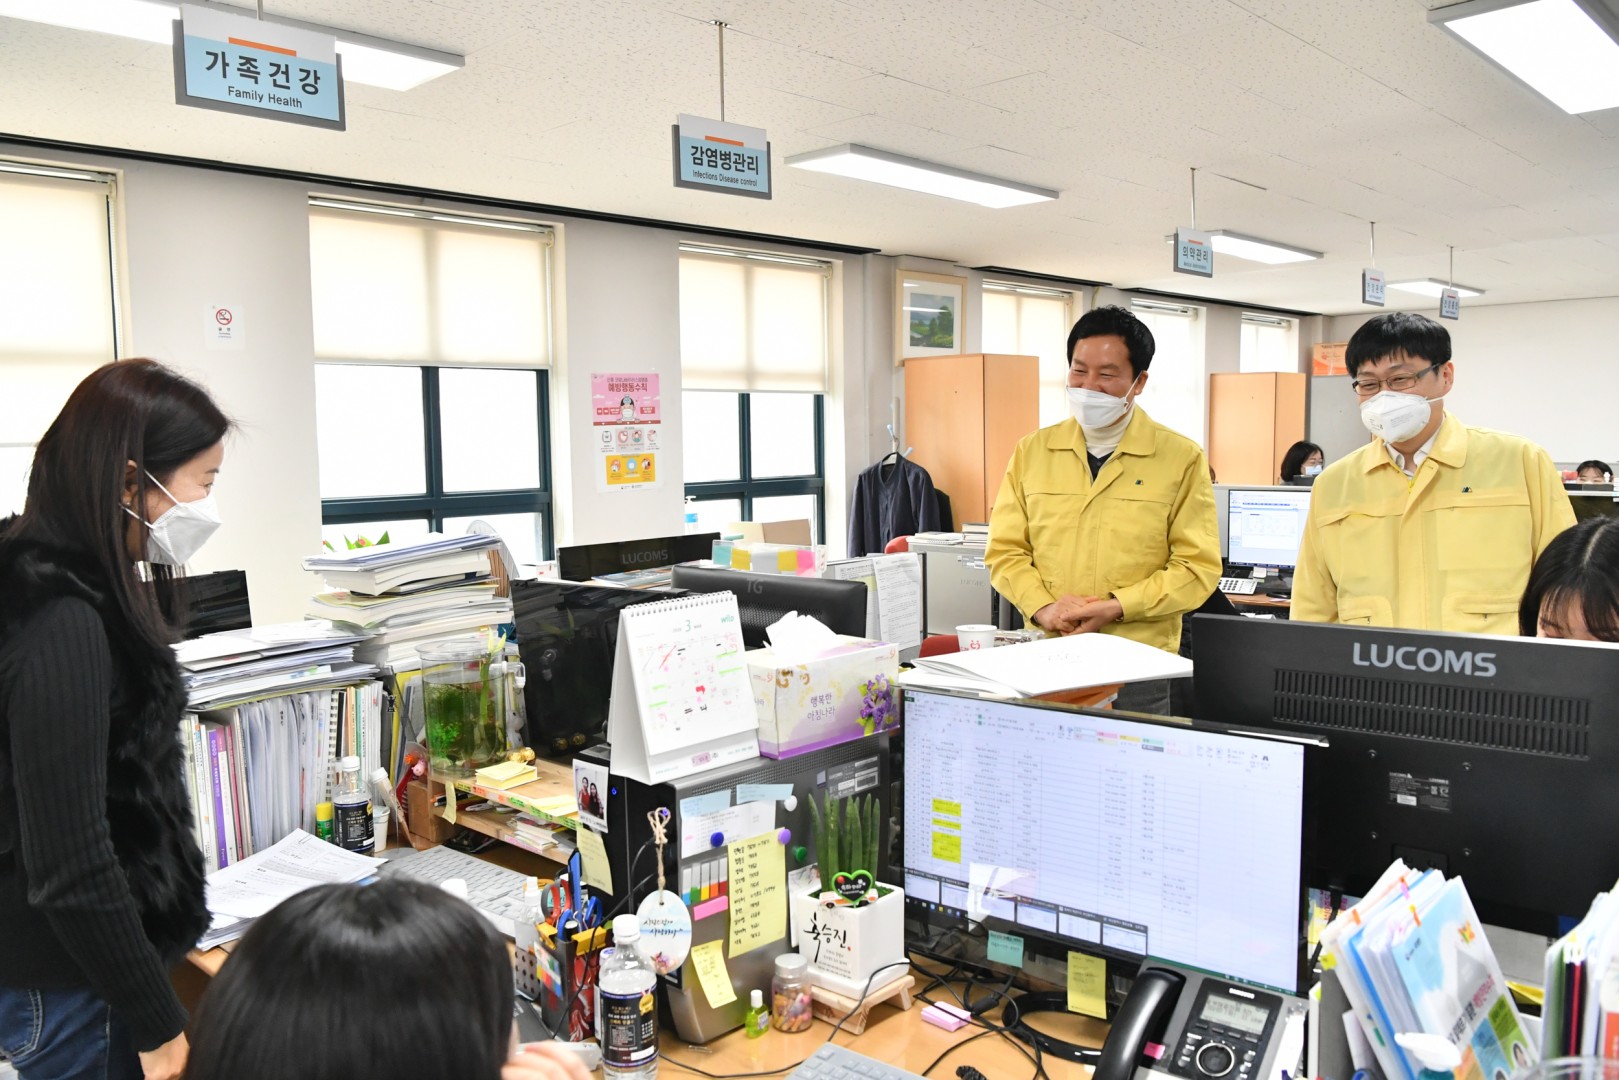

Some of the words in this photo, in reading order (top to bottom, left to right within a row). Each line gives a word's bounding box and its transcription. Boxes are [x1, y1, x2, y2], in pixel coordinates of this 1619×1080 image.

[205, 50, 321, 96] 가족건강
[228, 86, 264, 103] Family
[268, 93, 303, 109] Health
[690, 145, 759, 176] 감염병관리
[718, 173, 739, 185] Disease
[1182, 245, 1209, 263] 의약관리
[622, 549, 669, 565] LUCOMS
[685, 619, 691, 632] 3
[1352, 642, 1497, 678] LUCOMS
[810, 692, 832, 707] 행복한
[807, 706, 836, 722] 아침나라
[803, 911, 847, 964] 축승진
